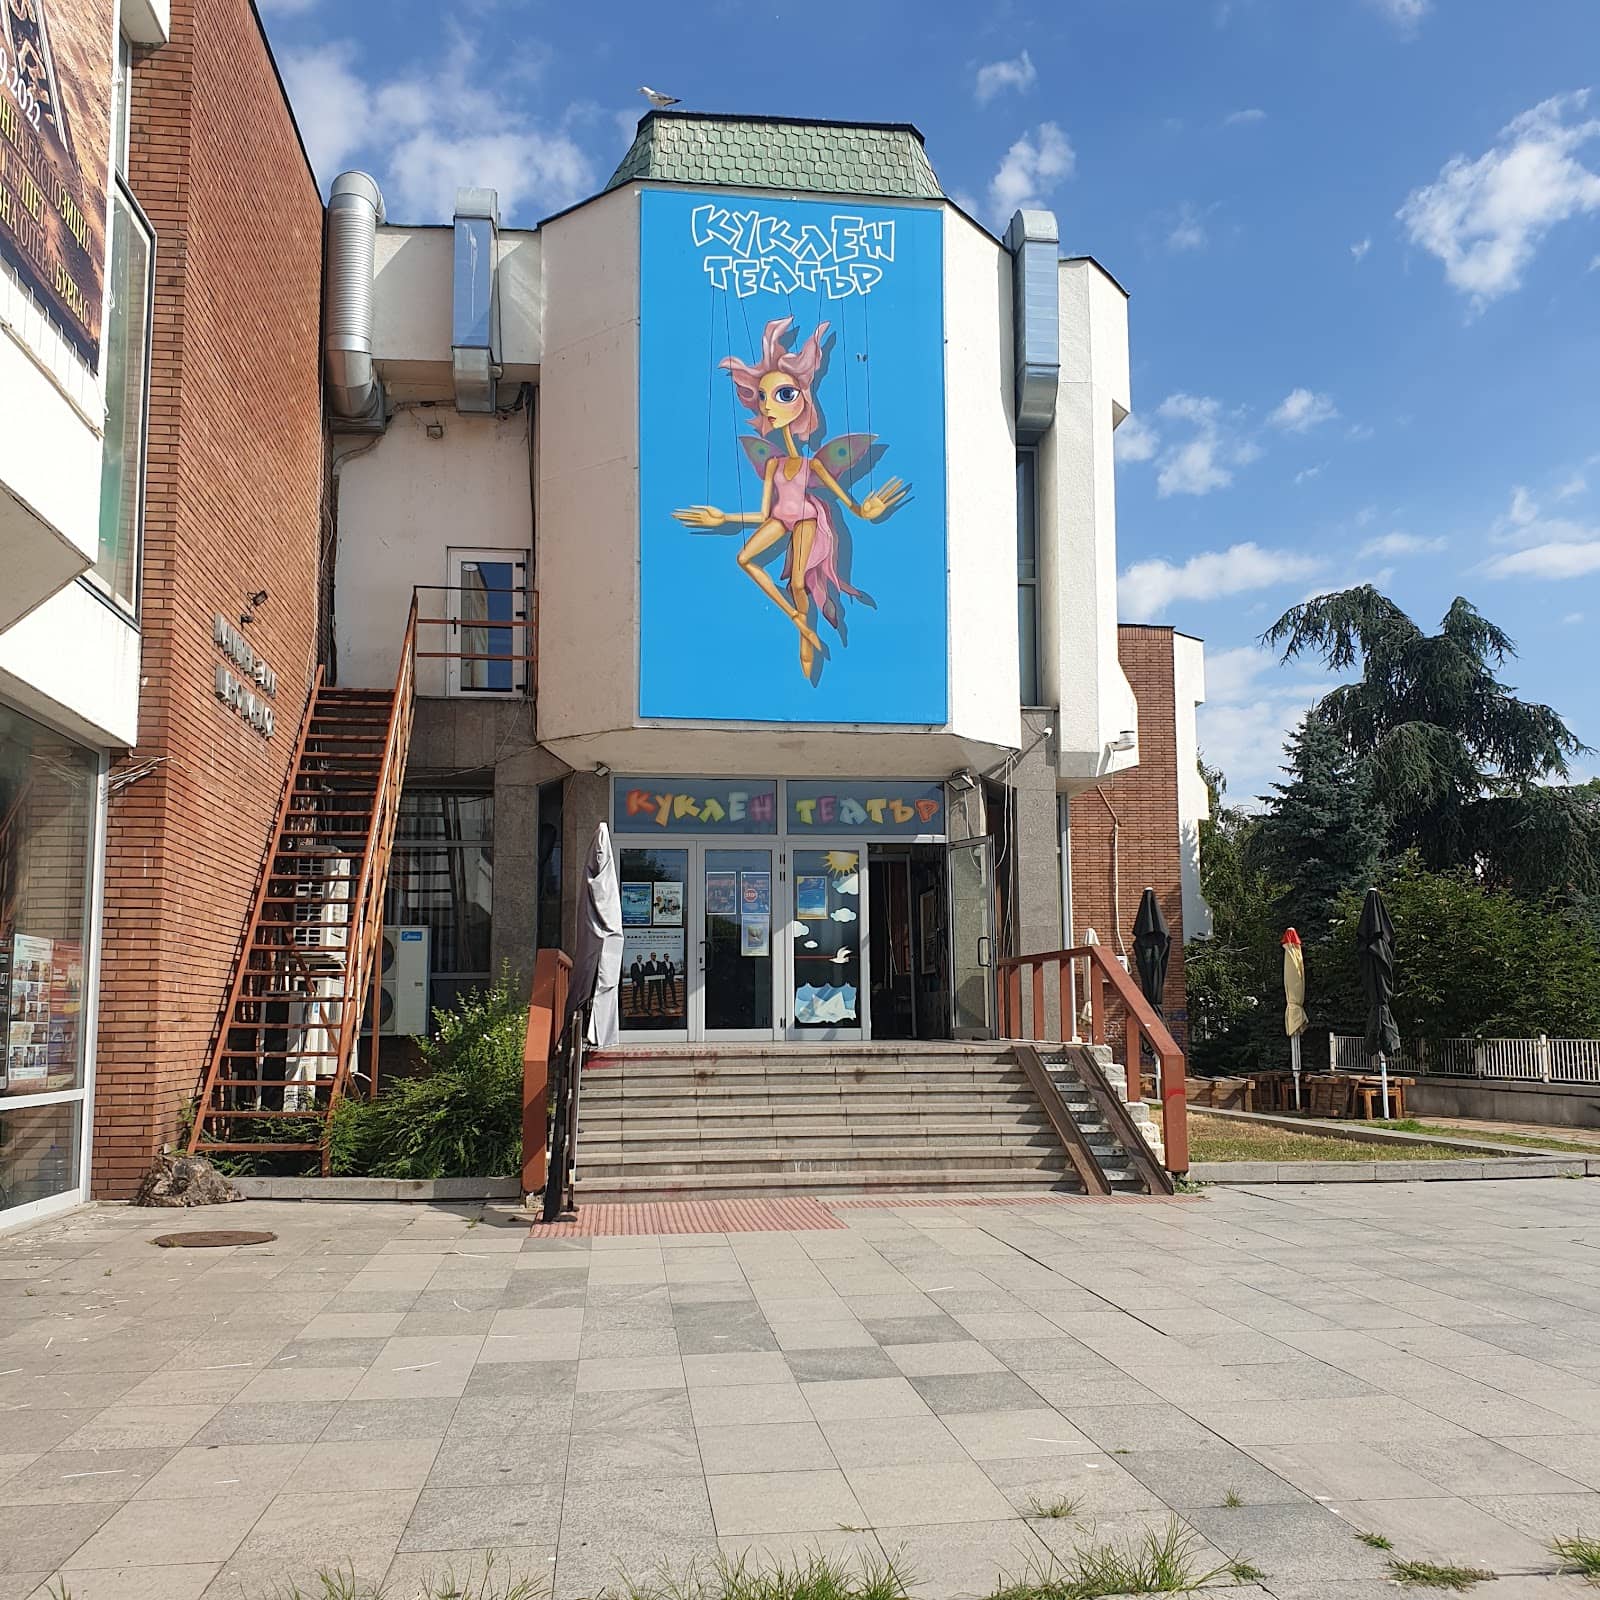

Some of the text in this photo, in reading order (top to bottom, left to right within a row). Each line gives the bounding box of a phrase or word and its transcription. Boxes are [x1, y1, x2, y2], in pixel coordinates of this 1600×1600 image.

[0, 95, 91, 257] ННА ЕКСПОЗИЦИЯ
[5, 147, 47, 230] ЕГИПЕТ
[692, 204, 895, 262] КУКЛЕН
[20, 213, 55, 284] ОПЕРА
[55, 260, 90, 329] БУРГАС
[704, 256, 883, 299] ТЕАТЪР
[626, 789, 939, 827] КУКЛЕН ТЕАТЪР
